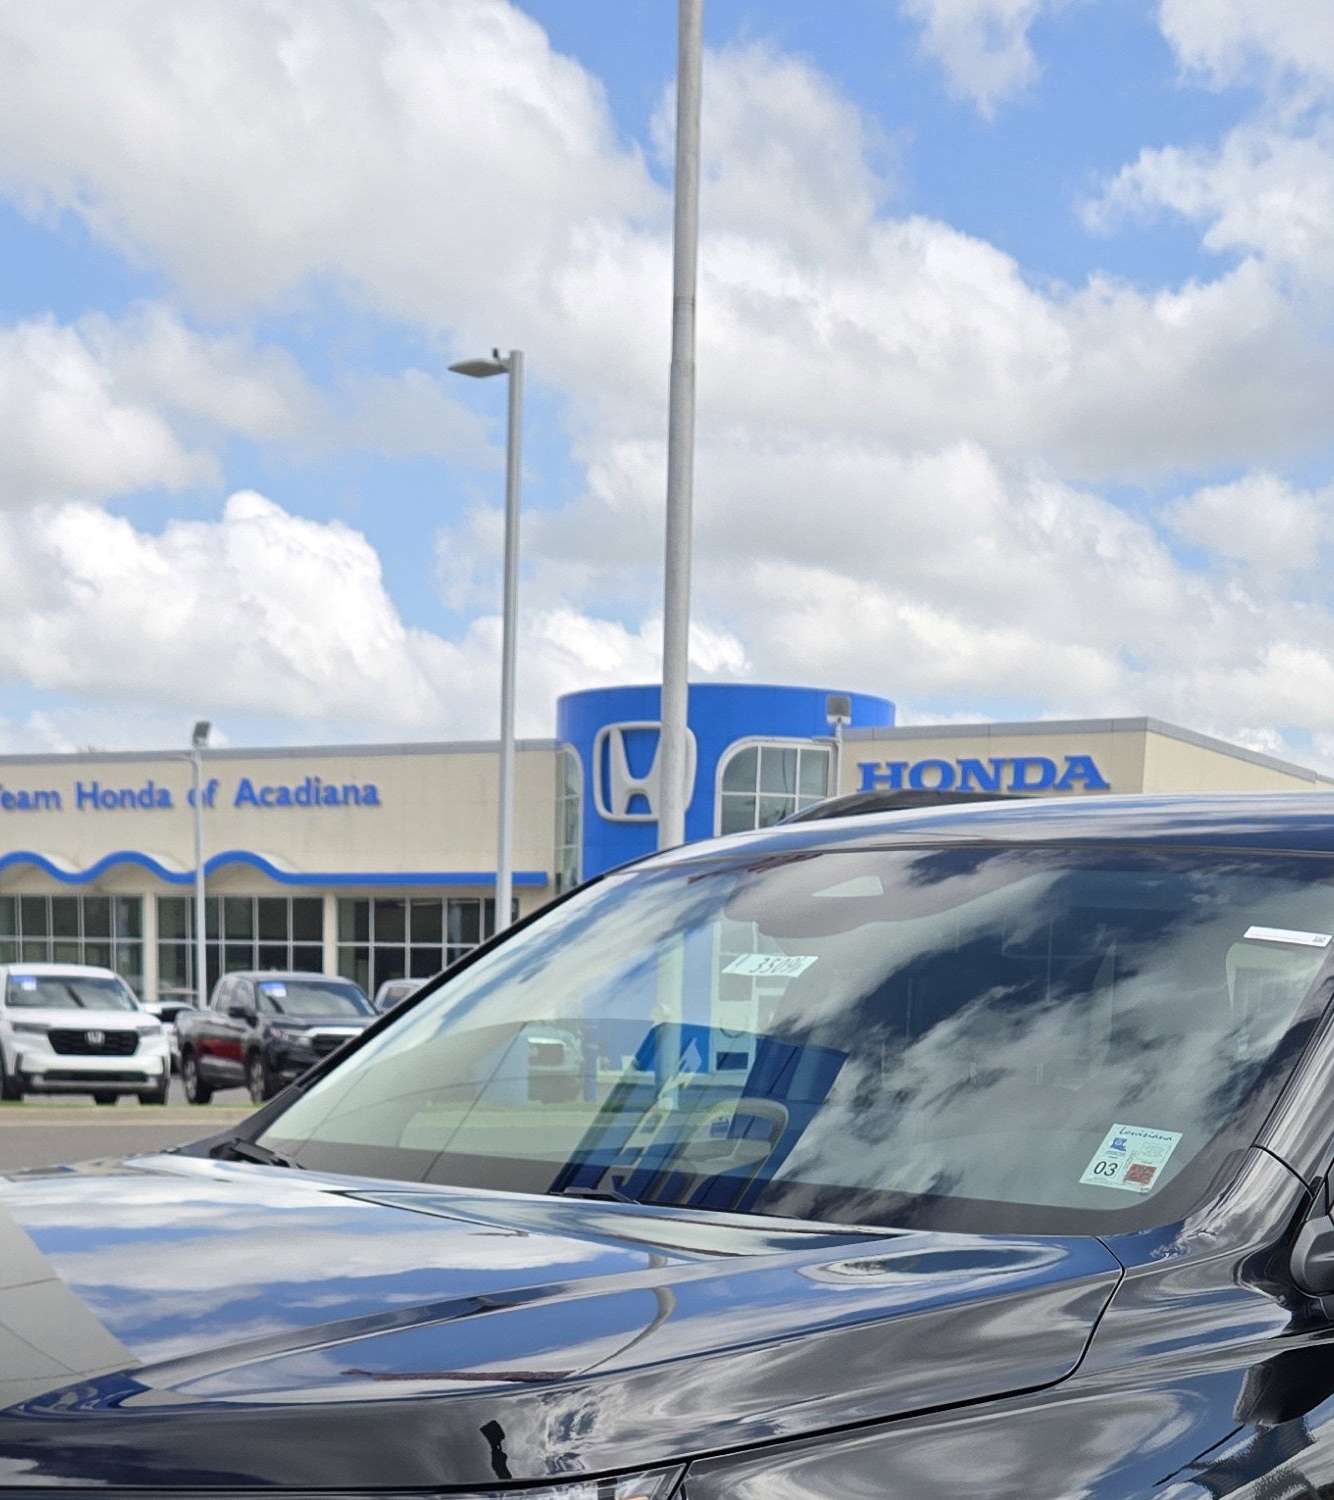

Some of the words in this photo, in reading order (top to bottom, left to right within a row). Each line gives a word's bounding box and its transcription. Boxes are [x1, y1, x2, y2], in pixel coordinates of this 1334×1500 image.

[856, 755, 1110, 792] HONDA
[75, 781, 171, 811] Honda
[187, 779, 218, 808] of
[233, 776, 380, 808] Acadiana
[1119, 1126, 1173, 1141] Louisiana
[1093, 1160, 1118, 1177] 03
